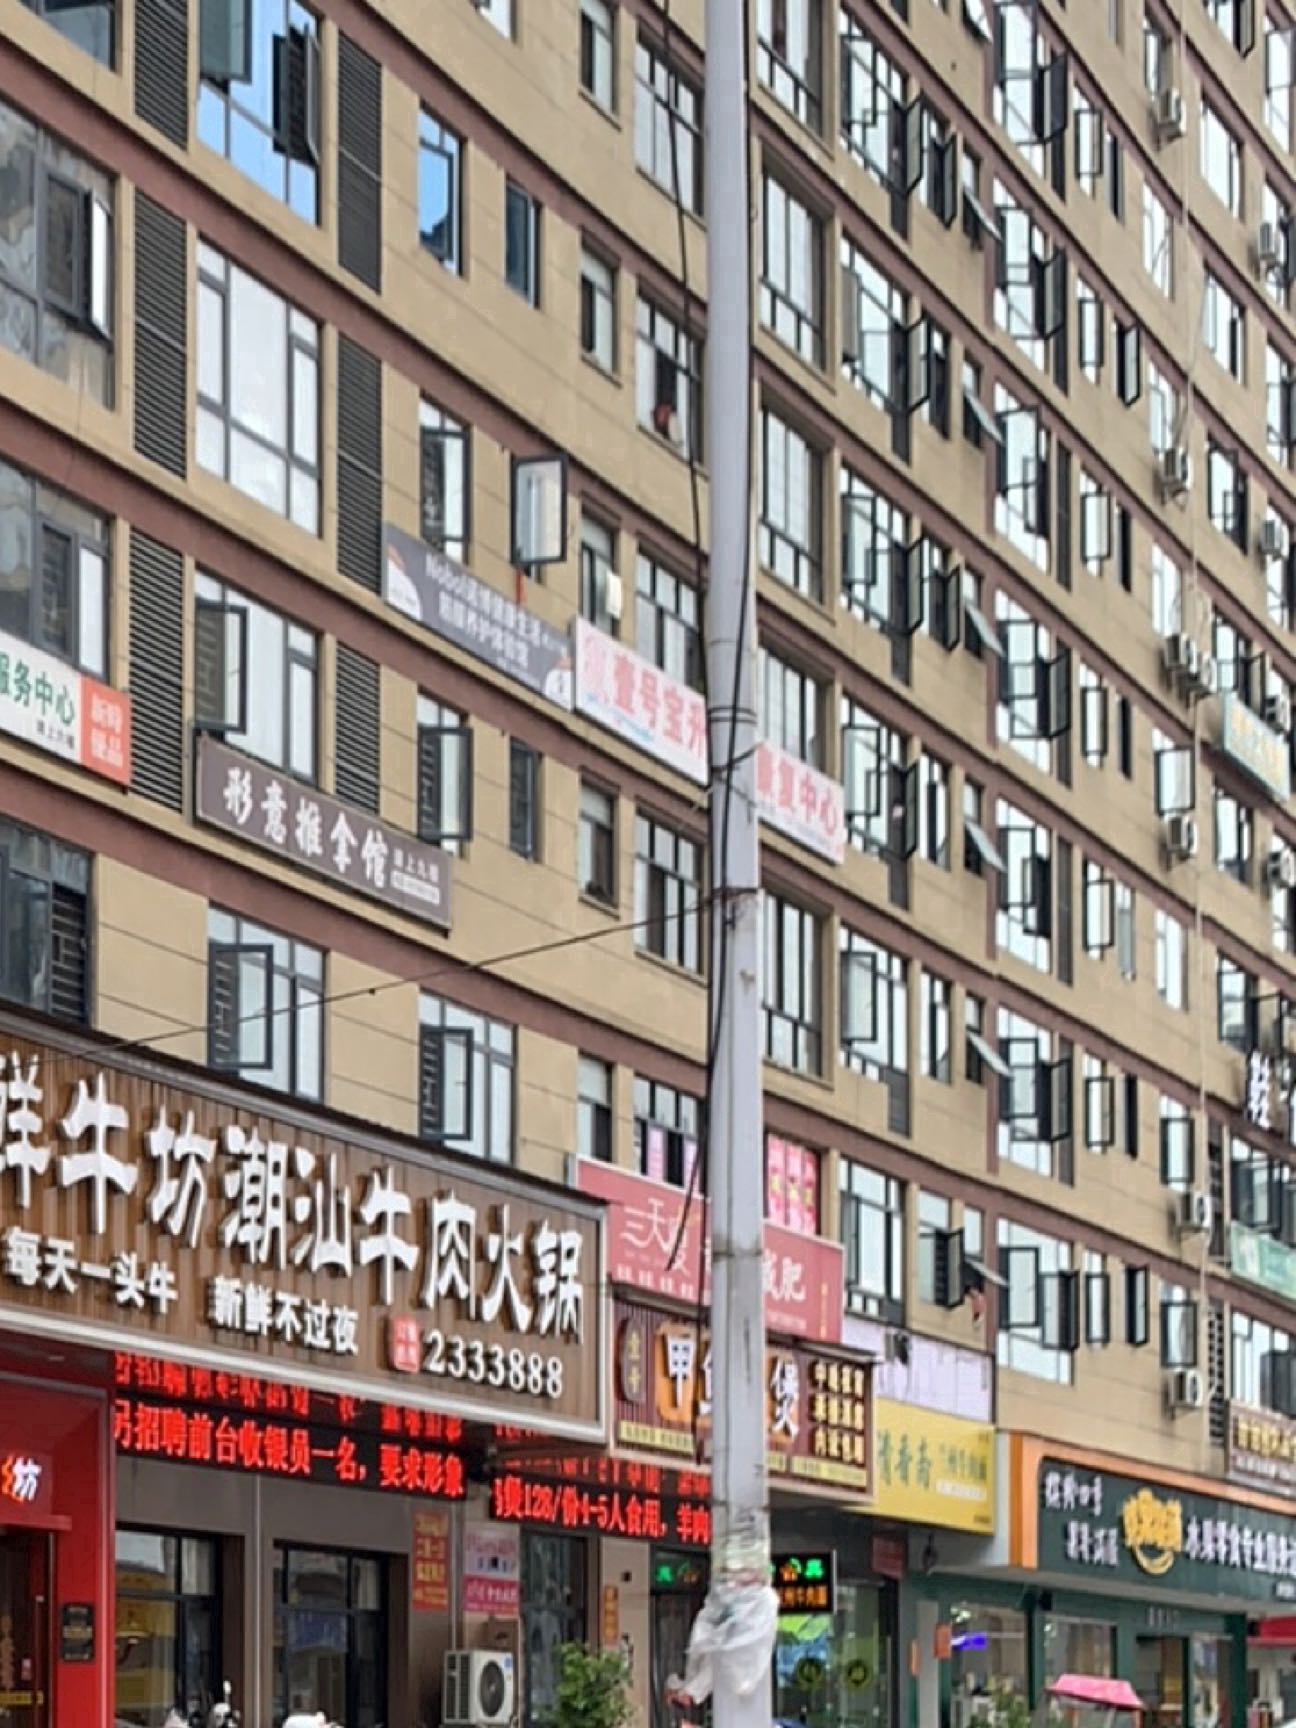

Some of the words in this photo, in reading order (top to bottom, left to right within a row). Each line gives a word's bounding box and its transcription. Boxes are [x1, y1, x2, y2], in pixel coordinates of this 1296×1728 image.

[1, 1225, 179, 1315] 每天一头牛
[207, 1274, 360, 1356] 新鲜不过夜
[424, 1328, 563, 1399] 2333888
